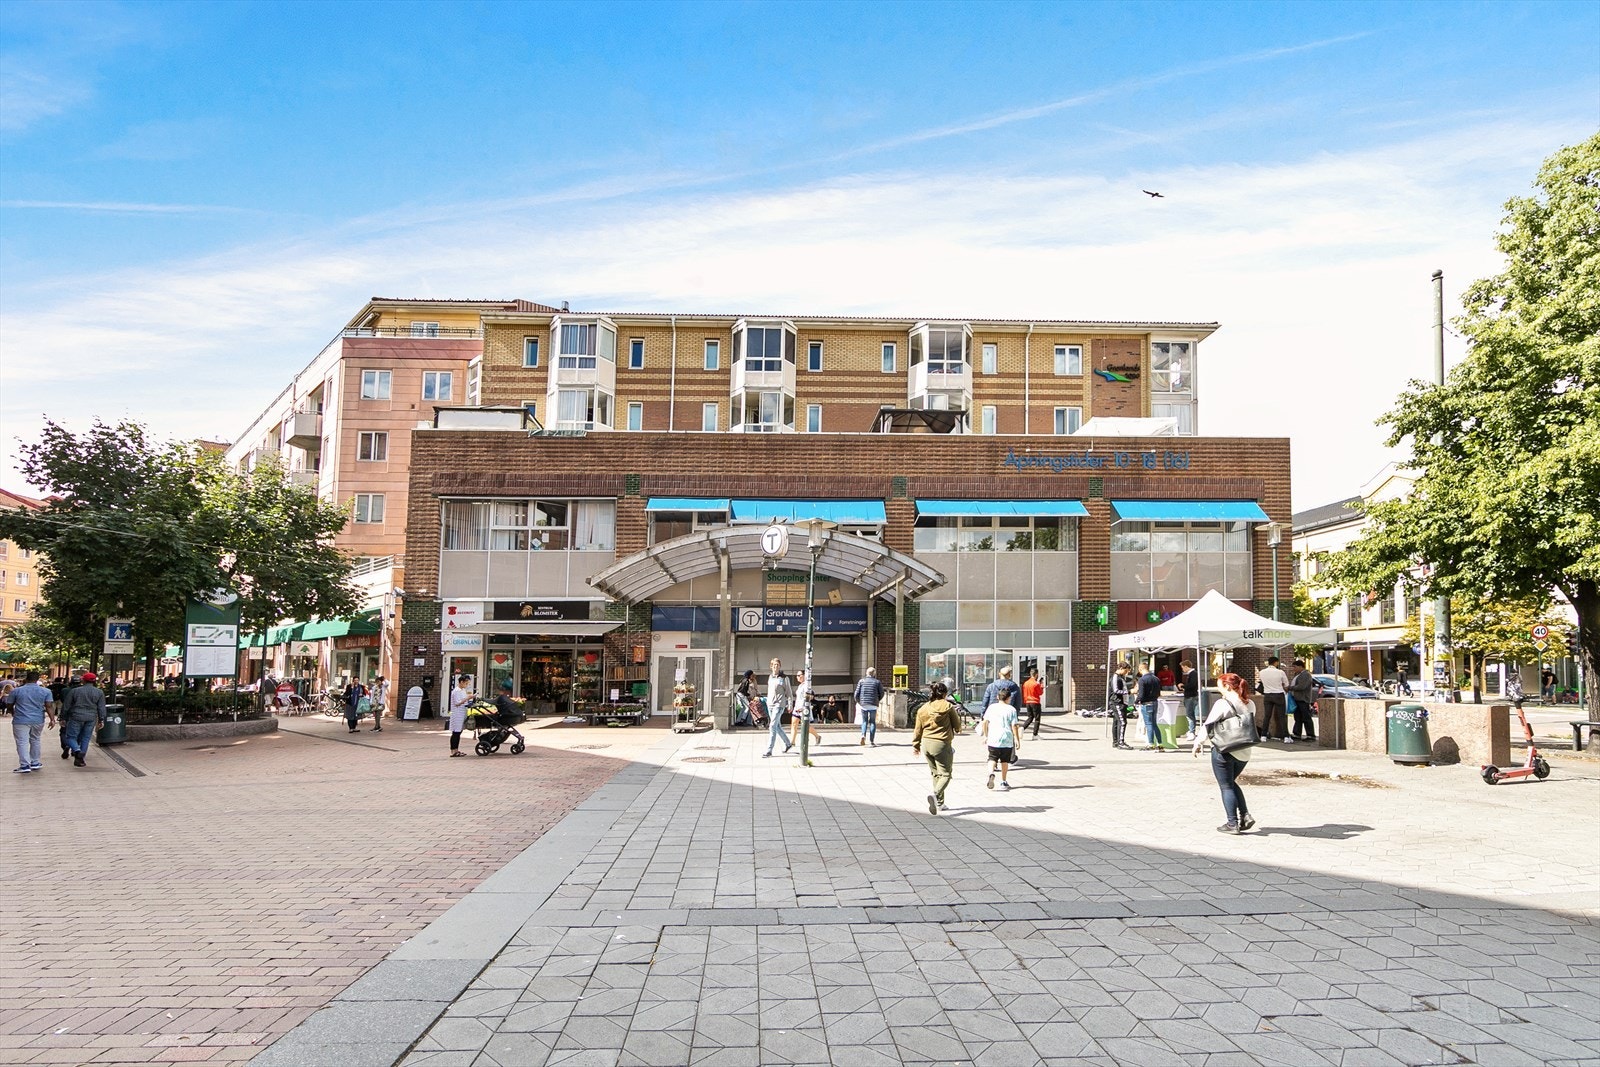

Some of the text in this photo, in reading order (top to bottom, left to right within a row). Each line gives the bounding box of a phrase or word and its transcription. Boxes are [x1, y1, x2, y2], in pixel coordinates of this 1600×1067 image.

[1114, 452, 1130, 468] 10
[1142, 452, 1156, 469] 18
[1164, 451, 1190, 470] (16)
[766, 533, 778, 550] T
[767, 574, 832, 582] Shopping Snter
[766, 608, 804, 618] Grønland
[1242, 630, 1292, 639] talkmore
